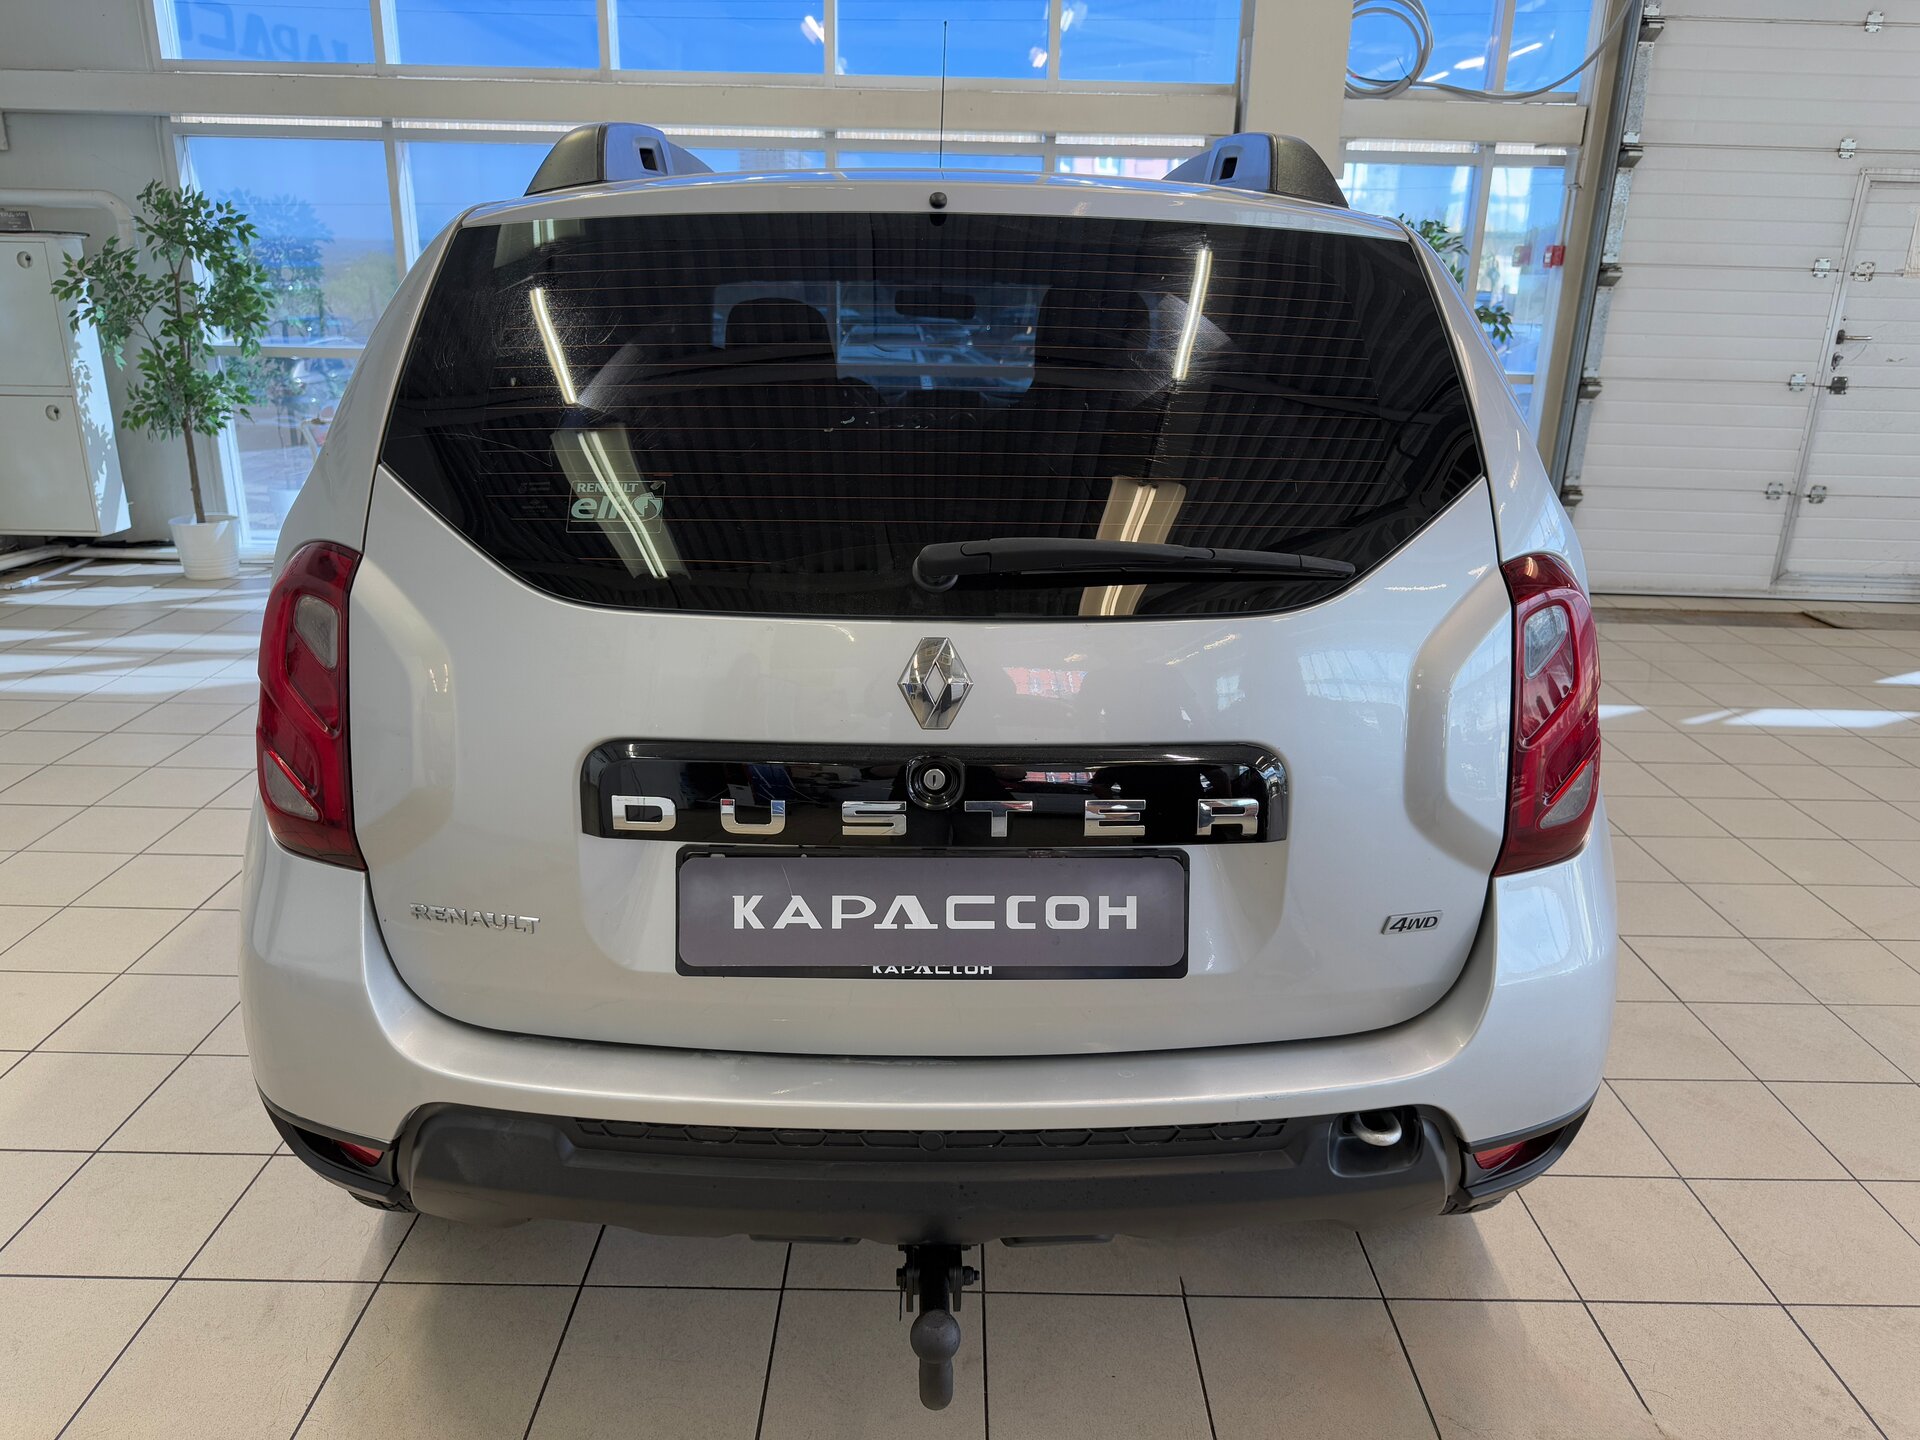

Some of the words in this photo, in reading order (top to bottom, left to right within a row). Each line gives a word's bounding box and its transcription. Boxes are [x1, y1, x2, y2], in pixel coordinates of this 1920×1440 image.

[577, 482, 638, 493] RENLT
[611, 795, 1260, 838] DUSTER
[410, 902, 540, 934] RENAULT
[1389, 916, 1438, 932] 4WD
